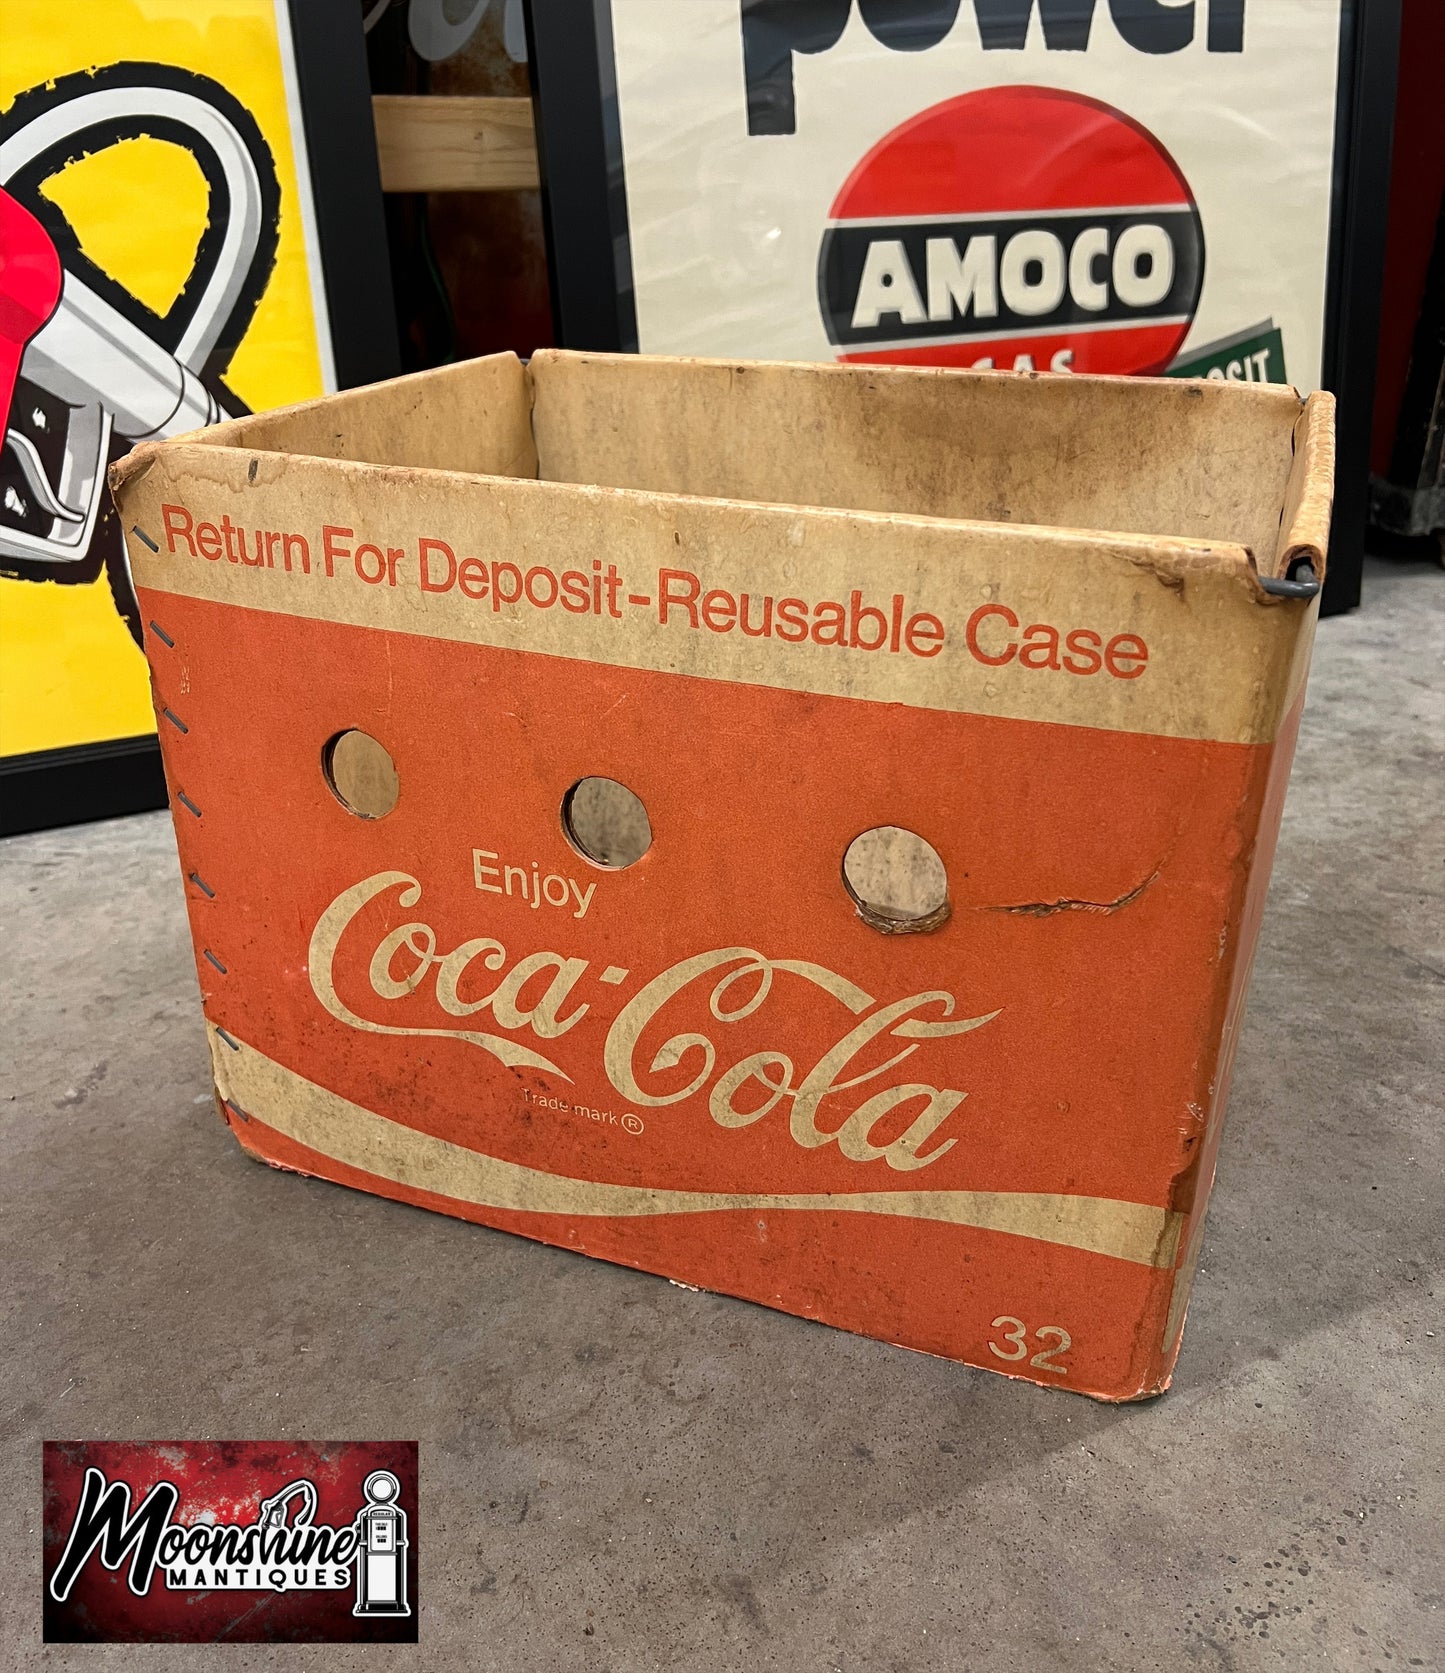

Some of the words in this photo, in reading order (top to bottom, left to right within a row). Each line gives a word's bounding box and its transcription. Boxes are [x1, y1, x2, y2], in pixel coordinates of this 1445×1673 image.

[851, 224, 1175, 328] AMOCO
[161, 504, 311, 574] Return
[322, 525, 404, 588] For
[965, 603, 1149, 680] Case
[472, 848, 597, 918] Enjoy
[308, 870, 1004, 1171] Coca-Cola
[521, 1087, 569, 1113] Trade
[988, 1315, 1072, 1375] 32
